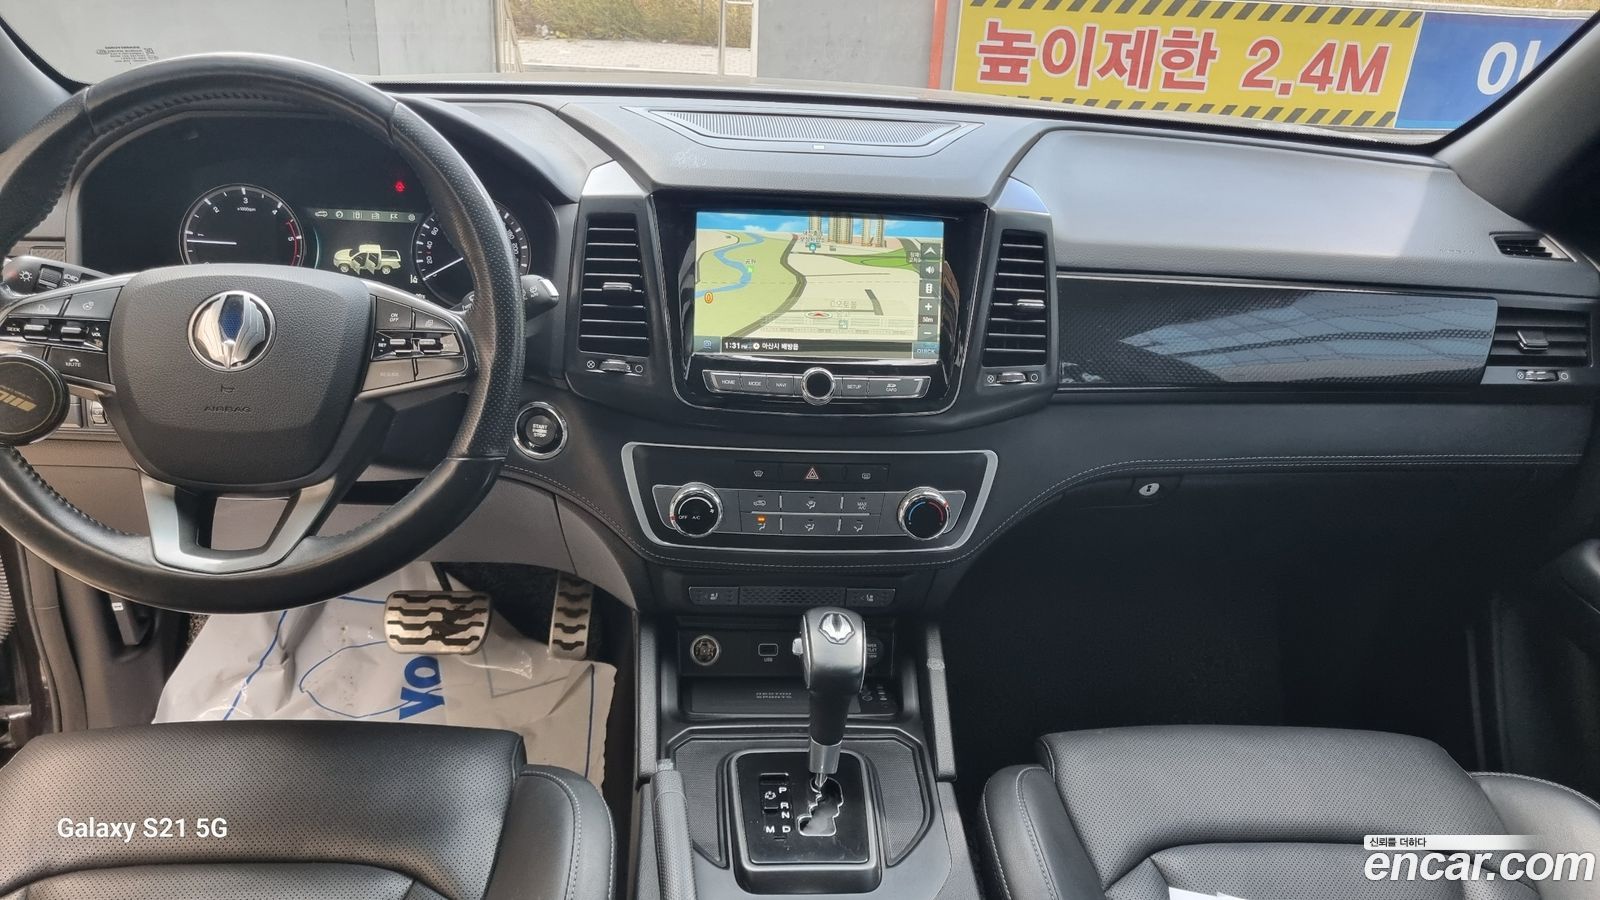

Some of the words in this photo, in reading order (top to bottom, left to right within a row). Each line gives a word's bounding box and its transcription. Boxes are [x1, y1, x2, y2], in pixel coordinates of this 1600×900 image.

[977, 20, 1218, 91] 높이제한
[1241, 38, 1390, 97] 2.4M
[426, 240, 433, 250] 40
[426, 255, 433, 265] 20
[778, 786, 787, 794] P
[781, 811, 790, 819] N
